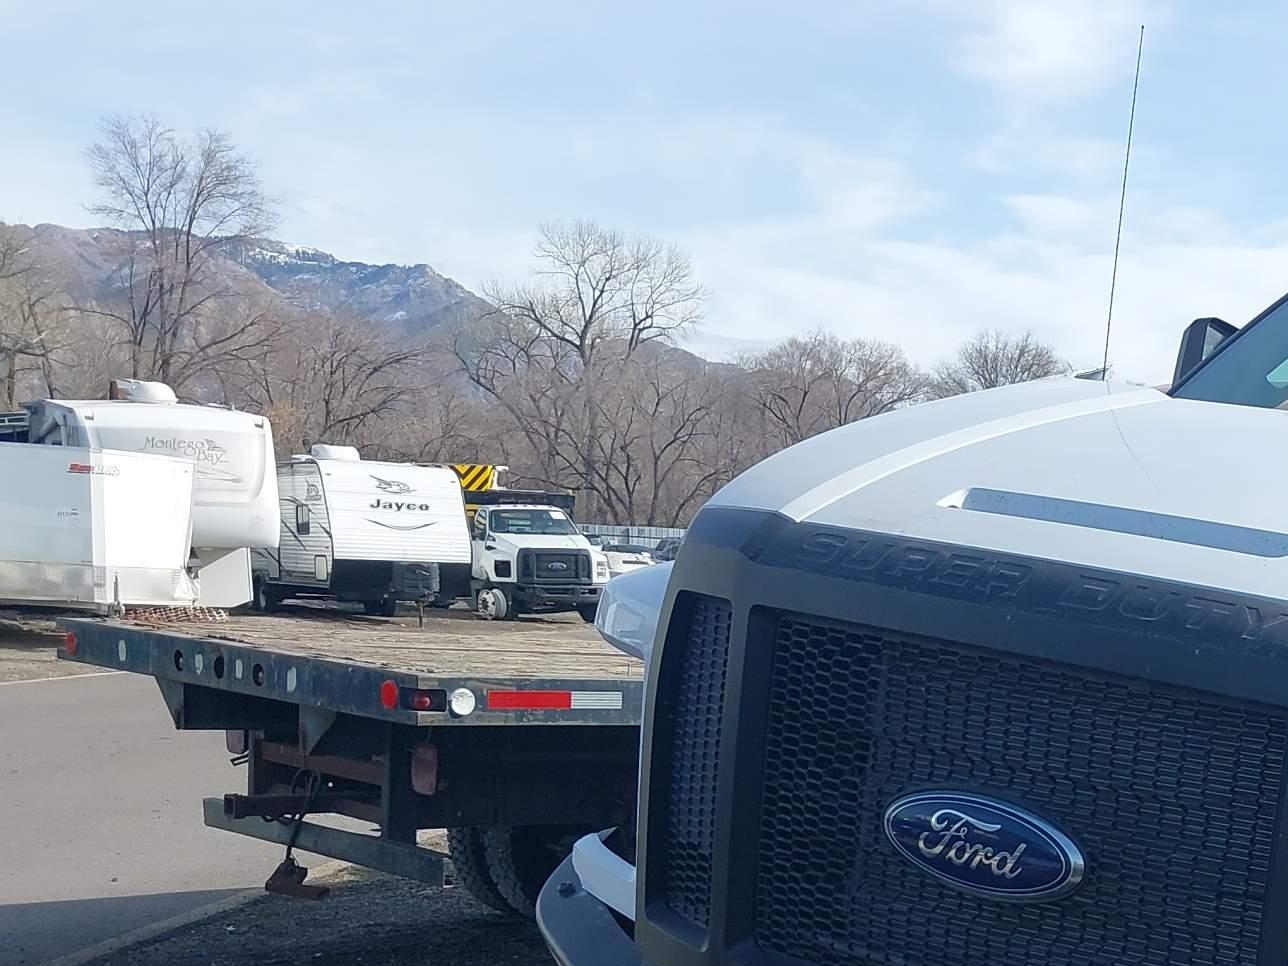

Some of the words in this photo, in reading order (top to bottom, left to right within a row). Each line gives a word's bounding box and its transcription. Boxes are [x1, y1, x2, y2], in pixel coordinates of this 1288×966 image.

[143, 436, 205, 457] Montego
[197, 449, 223, 466] Bay
[369, 499, 429, 511] Jayco
[800, 532, 1035, 597] SUPER
[918, 809, 1027, 879] Ford
